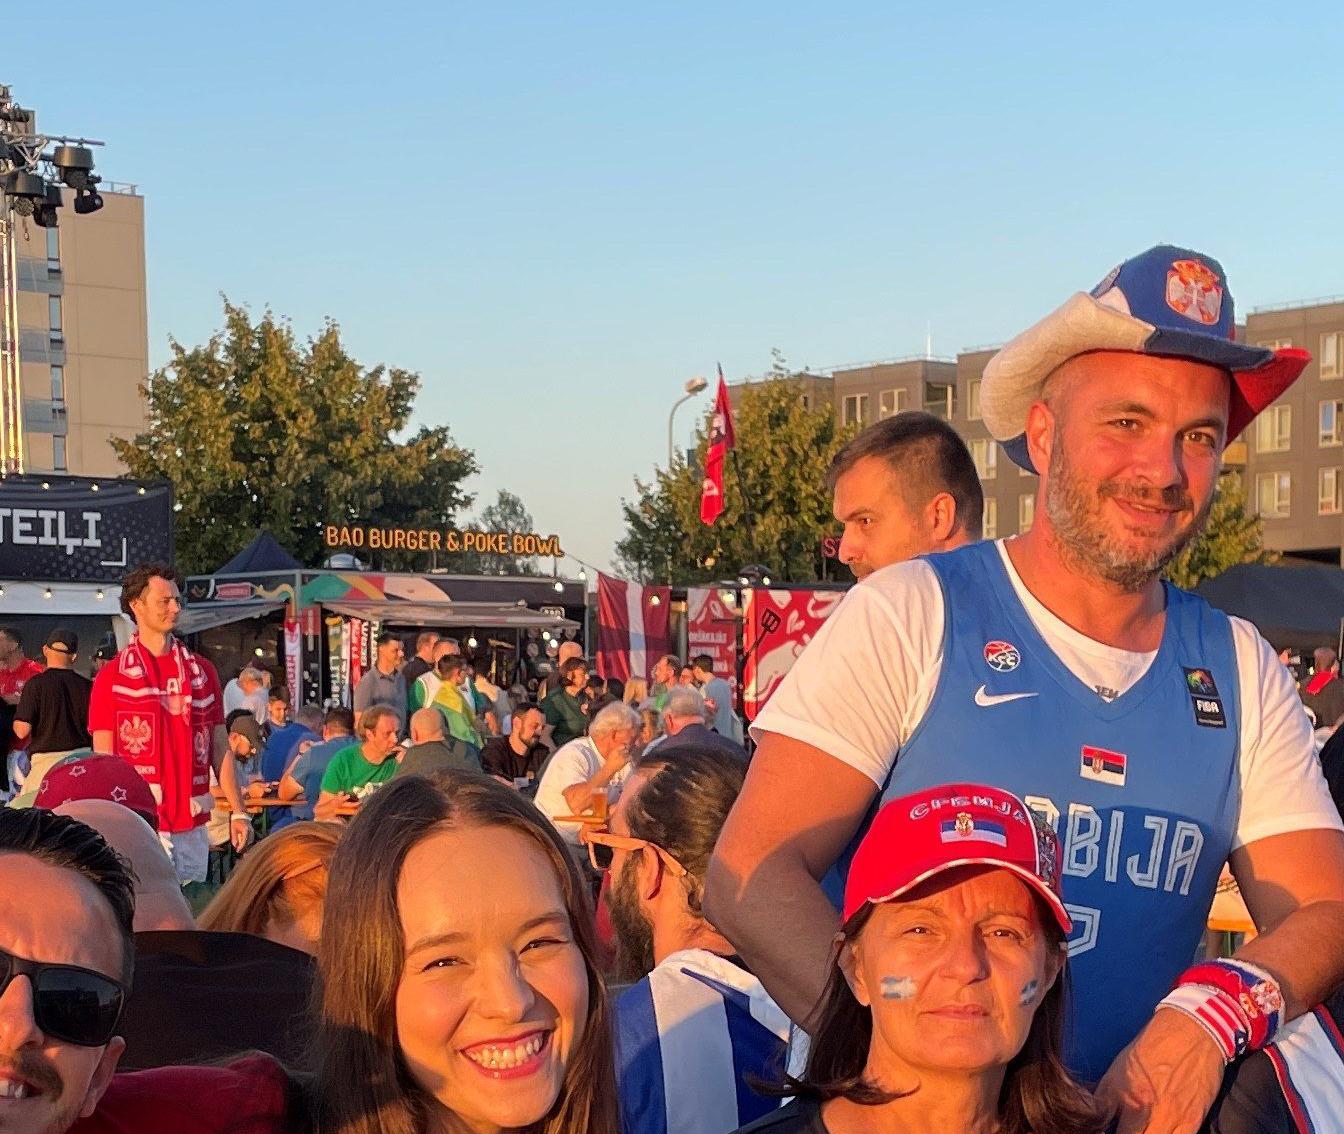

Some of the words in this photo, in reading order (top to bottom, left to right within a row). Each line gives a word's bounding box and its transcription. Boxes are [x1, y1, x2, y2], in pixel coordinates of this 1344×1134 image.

[326, 526, 364, 547] BAO
[369, 528, 441, 551] BURGER
[446, 530, 461, 553] &
[463, 531, 509, 554] POKE
[513, 534, 565, 558] BOWL
